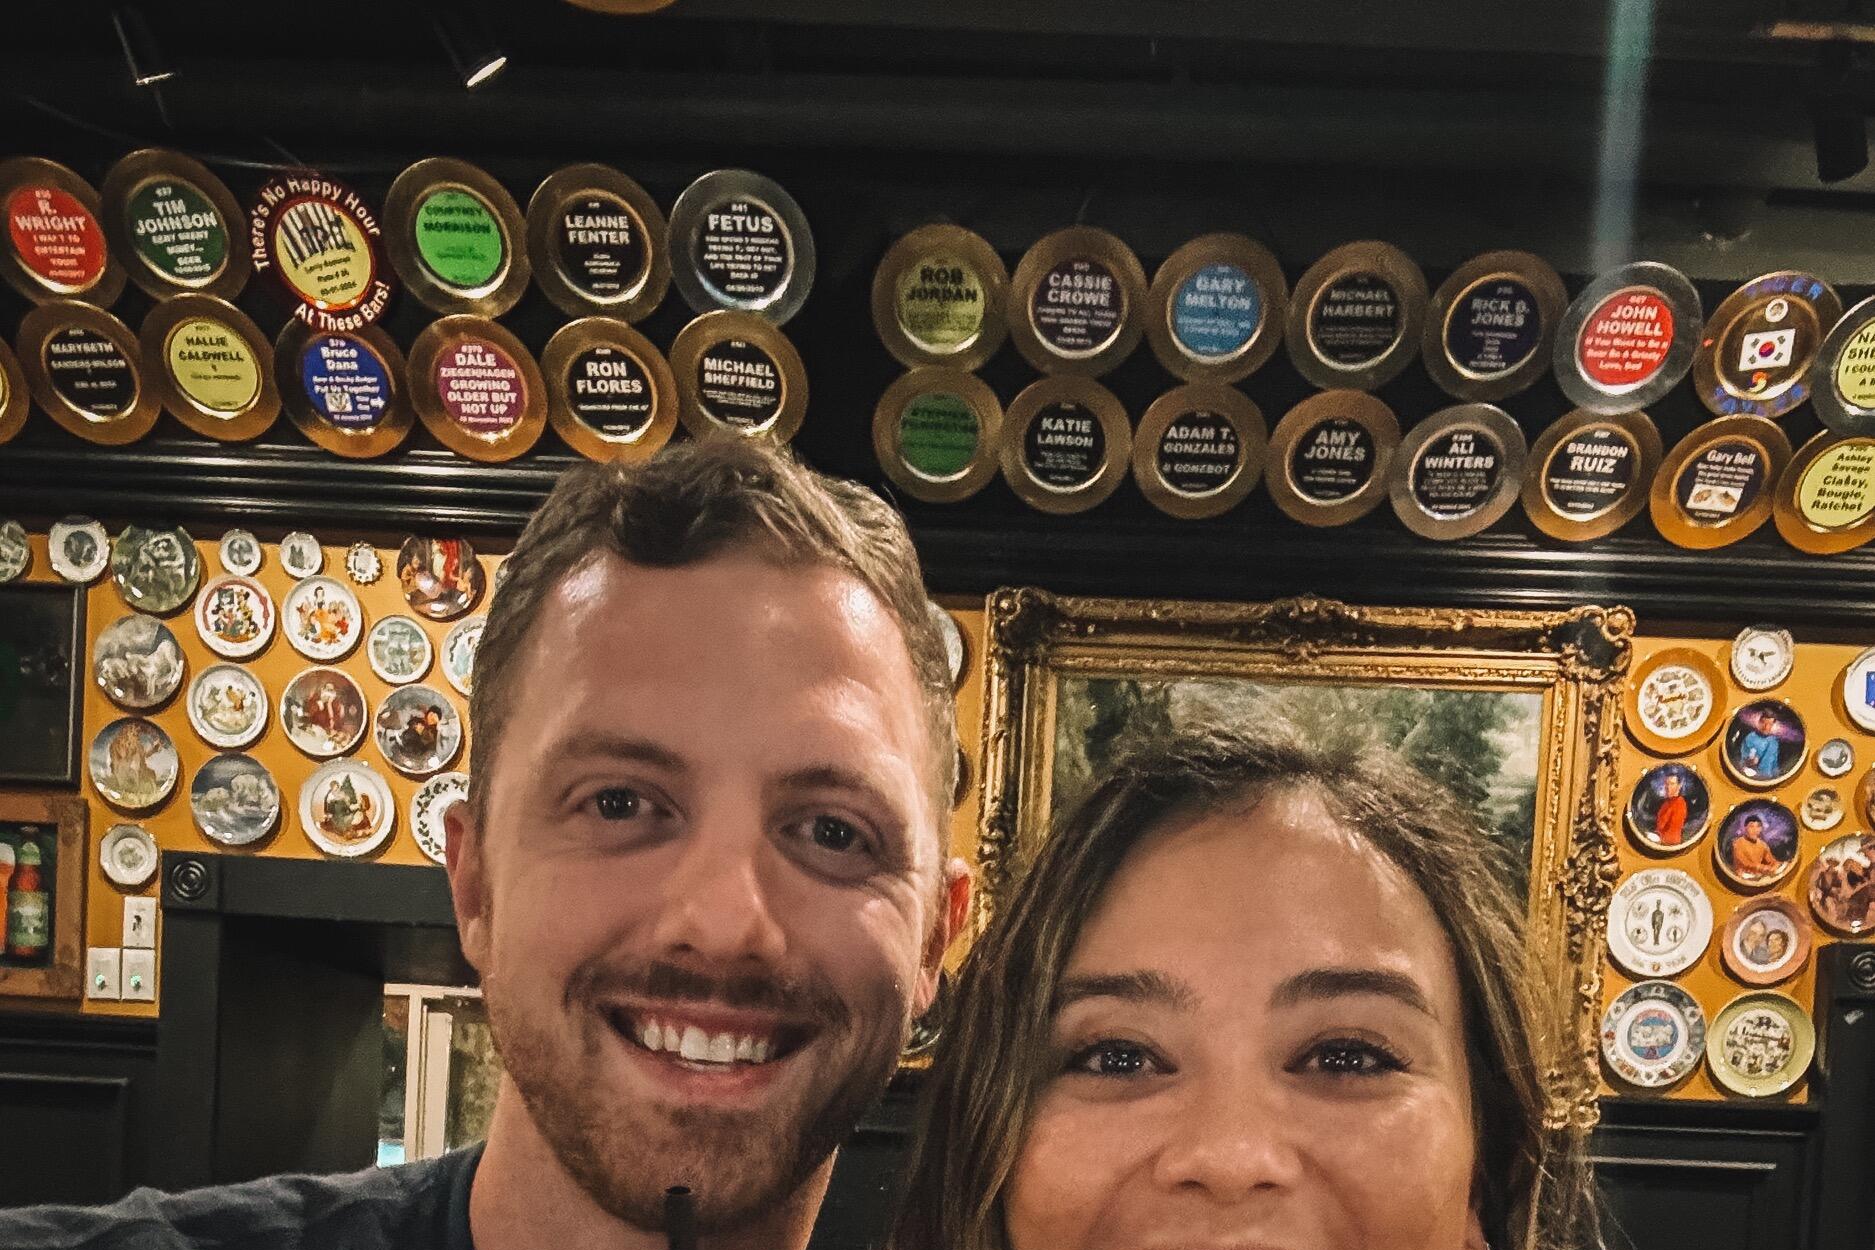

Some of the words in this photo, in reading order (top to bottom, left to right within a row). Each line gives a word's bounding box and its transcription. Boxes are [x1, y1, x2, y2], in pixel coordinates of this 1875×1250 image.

[153, 199, 187, 216] TIM
[15, 216, 86, 231] WRIGHT
[136, 212, 217, 235] JOHNSON
[251, 204, 270, 272] There's
[261, 184, 286, 207] No
[286, 177, 342, 201] Happy
[344, 192, 381, 237] Hour
[564, 214, 630, 229] LEANNE
[708, 213, 774, 232] FETUS
[568, 230, 631, 245] FENTER
[1048, 272, 1112, 290] CASSIE
[294, 303, 315, 326] At
[317, 311, 363, 331] These
[359, 281, 391, 323] Bars!
[1610, 305, 1658, 320] JOHN
[1471, 312, 1525, 328] JONES
[1596, 320, 1664, 337] HOWELL
[185, 336, 228, 347] HALLIE
[178, 350, 245, 362] CALDWELL
[320, 346, 358, 359] Bruce
[455, 353, 497, 367] DALE
[325, 359, 358, 371] Dana
[585, 361, 627, 377] RON
[703, 357, 775, 378] MICHAEL
[449, 379, 511, 391] GROWING
[576, 379, 643, 395] FLORES
[704, 371, 775, 390] SHEFFIELD
[447, 390, 490, 403] OLDER
[490, 392, 518, 404] BUT
[460, 403, 487, 415] NOT
[489, 403, 509, 415] UP
[1041, 417, 1092, 433] KATIE
[1037, 433, 1094, 448] LAWSON
[1166, 425, 1215, 440] ADAM
[1219, 427, 1236, 441] T.
[1315, 429, 1361, 446] AMY
[1163, 443, 1235, 455] GONZALES
[1304, 446, 1366, 461] JONES
[1448, 442, 1475, 455] ALI
[1566, 442, 1629, 458] BRANDON
[1424, 456, 1494, 469] WINTERS
[1569, 456, 1617, 473] RUIZ
[1706, 450, 1734, 465] Gary
[1836, 453, 1873, 464] Ashley
